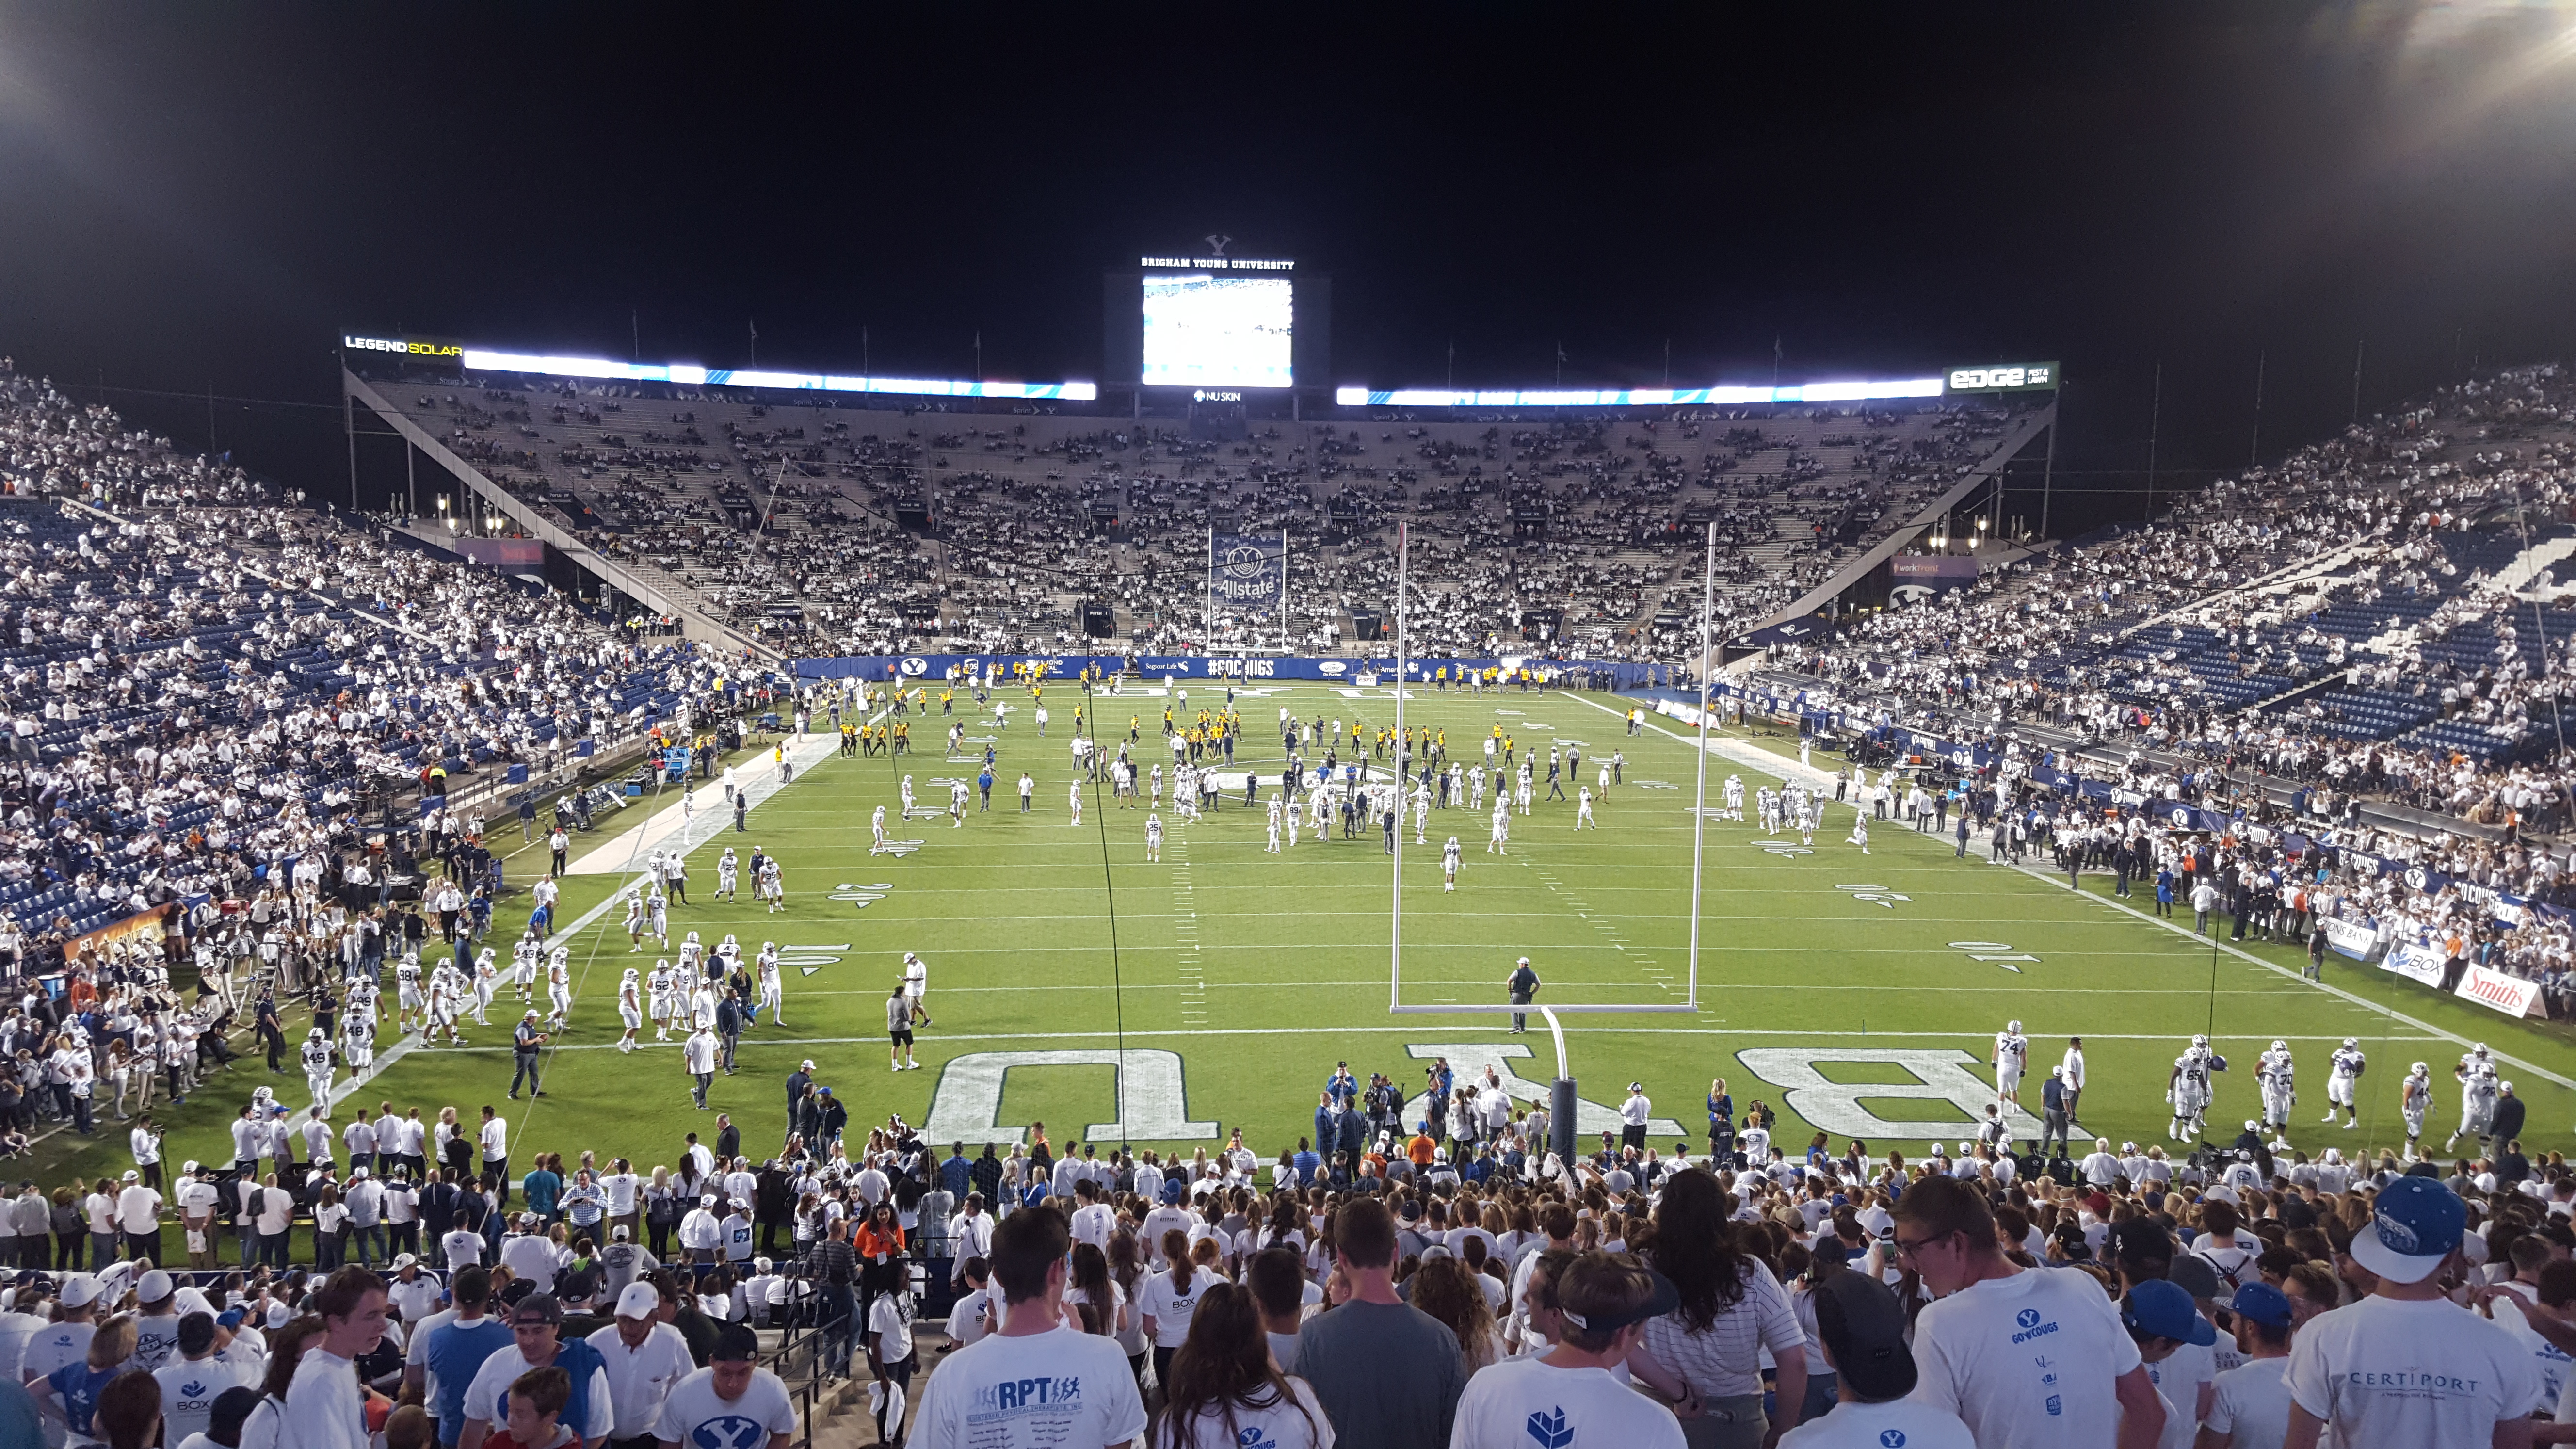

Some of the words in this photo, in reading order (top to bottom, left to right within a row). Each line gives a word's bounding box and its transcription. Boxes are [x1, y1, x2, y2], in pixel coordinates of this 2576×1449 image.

[1206, 235, 1231, 256] Y
[1142, 258, 1190, 267] BRIGHAM
[1193, 259, 1228, 269] YOUNG
[1232, 260, 1295, 270] UNIVERSITY
[1206, 392, 1220, 402] NU
[1221, 392, 1241, 402] SKIN
[1218, 580, 1274, 596] Allstate
[2346, 930, 2369, 945] BANK
[523, 950, 534, 959] 43
[2409, 955, 2445, 976] BOX
[400, 970, 411, 981] 98
[656, 981, 669, 990] 62
[2465, 969, 2525, 1008] Smith's
[348, 1027, 363, 1036] 48
[2000, 1040, 2018, 1054] 74
[309, 1053, 325, 1063] 49
[1173, 1297, 1194, 1308] BOX
[2350, 1362, 2479, 1393] CERTIPORT
[999, 1377, 1051, 1410] RPT
[177, 1400, 211, 1410] BOX
